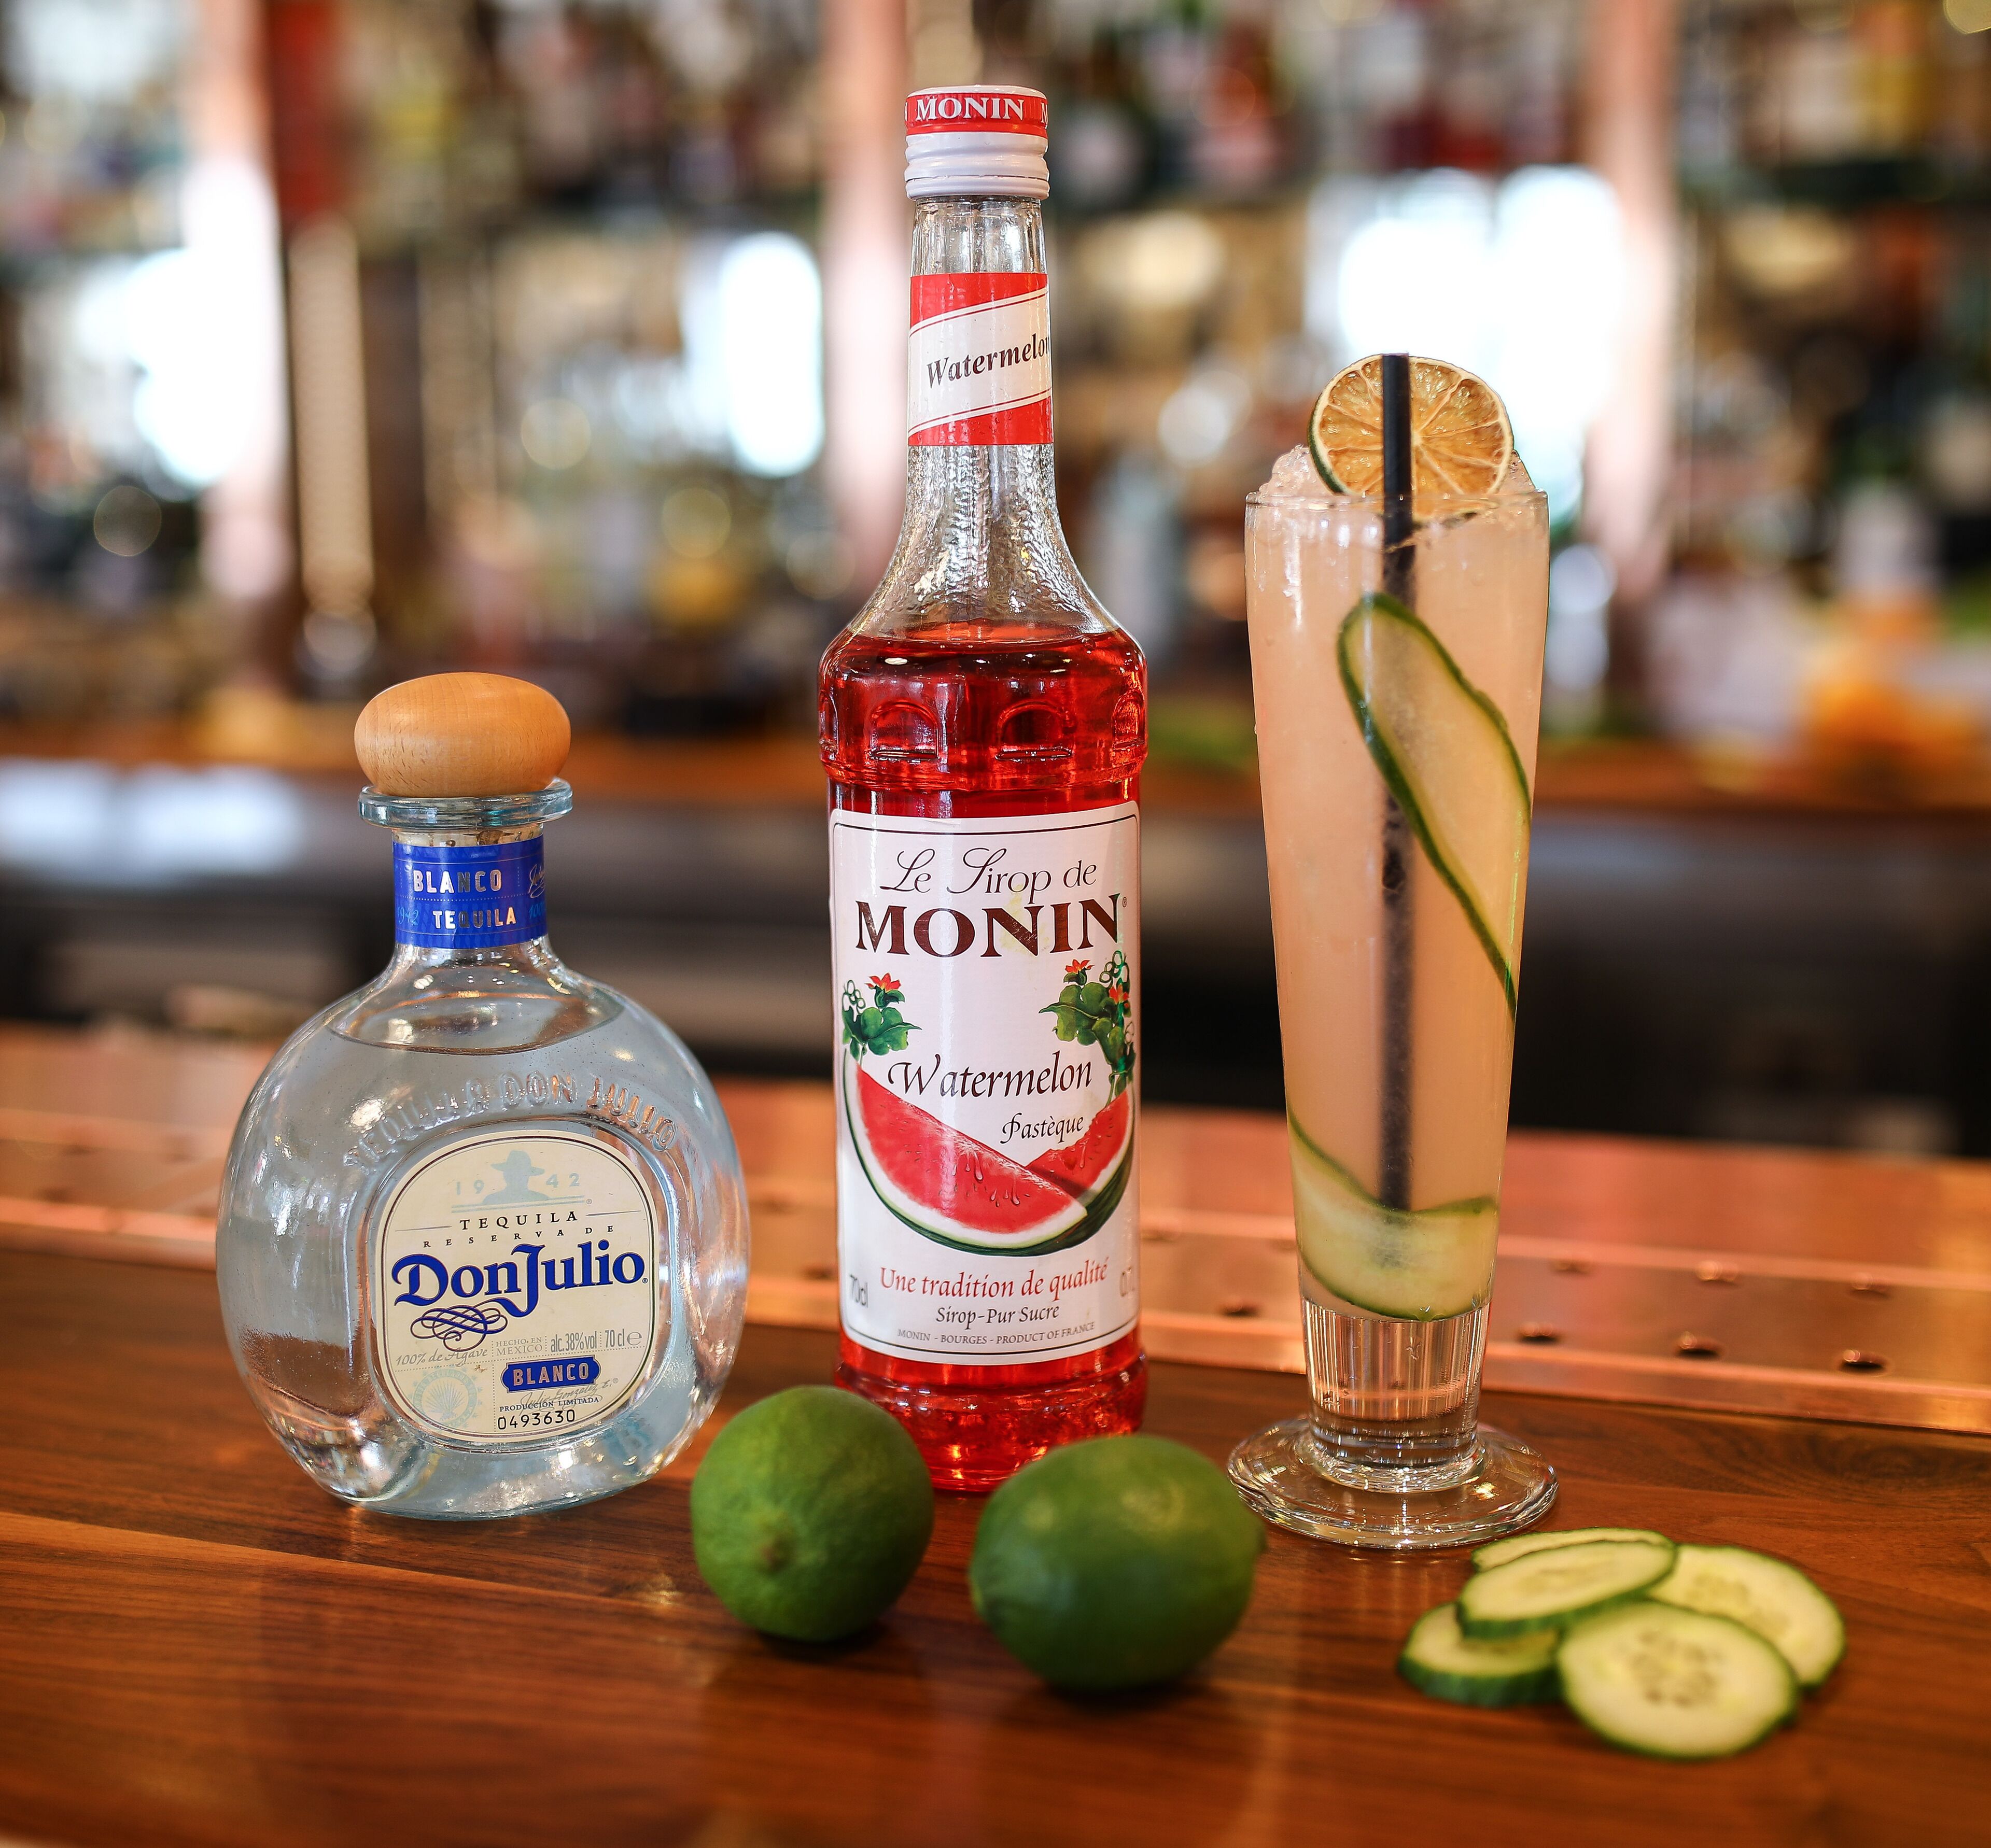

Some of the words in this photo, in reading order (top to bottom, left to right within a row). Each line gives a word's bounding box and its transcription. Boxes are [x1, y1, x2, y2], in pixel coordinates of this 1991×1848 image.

[916, 97, 1025, 120] MONIN
[414, 869, 502, 893] BLANCO
[879, 848, 935, 893] Le
[946, 848, 1051, 904] Sirop
[1063, 860, 1097, 888] de
[433, 907, 516, 929] TEQUILA
[856, 893, 1120, 958] MONIN
[888, 1051, 1092, 1097] Watermelon
[1000, 1112, 1084, 1144] Pastèque
[460, 1211, 578, 1231] TEQUILA
[880, 1267, 916, 1293] Une
[921, 1271, 1015, 1297] tradition
[1021, 1268, 1044, 1296] de
[1049, 1257, 1109, 1302] qualité
[1019, 1305, 1060, 1322] Sucre
[898, 1328, 931, 1342] MONIN
[941, 1334, 988, 1344] BOURGES
[996, 1332, 1046, 1344] PRODUCT
[1047, 1331, 1060, 1339] OF
[1061, 1321, 1095, 1337] FRANCE
[396, 1352, 427, 1366] 100%
[429, 1348, 443, 1362] de
[497, 1344, 543, 1356] MEXICO
[513, 1363, 589, 1387] BLANCO
[558, 1396, 599, 1407] LIMITADA
[497, 1409, 575, 1430] 0493630
